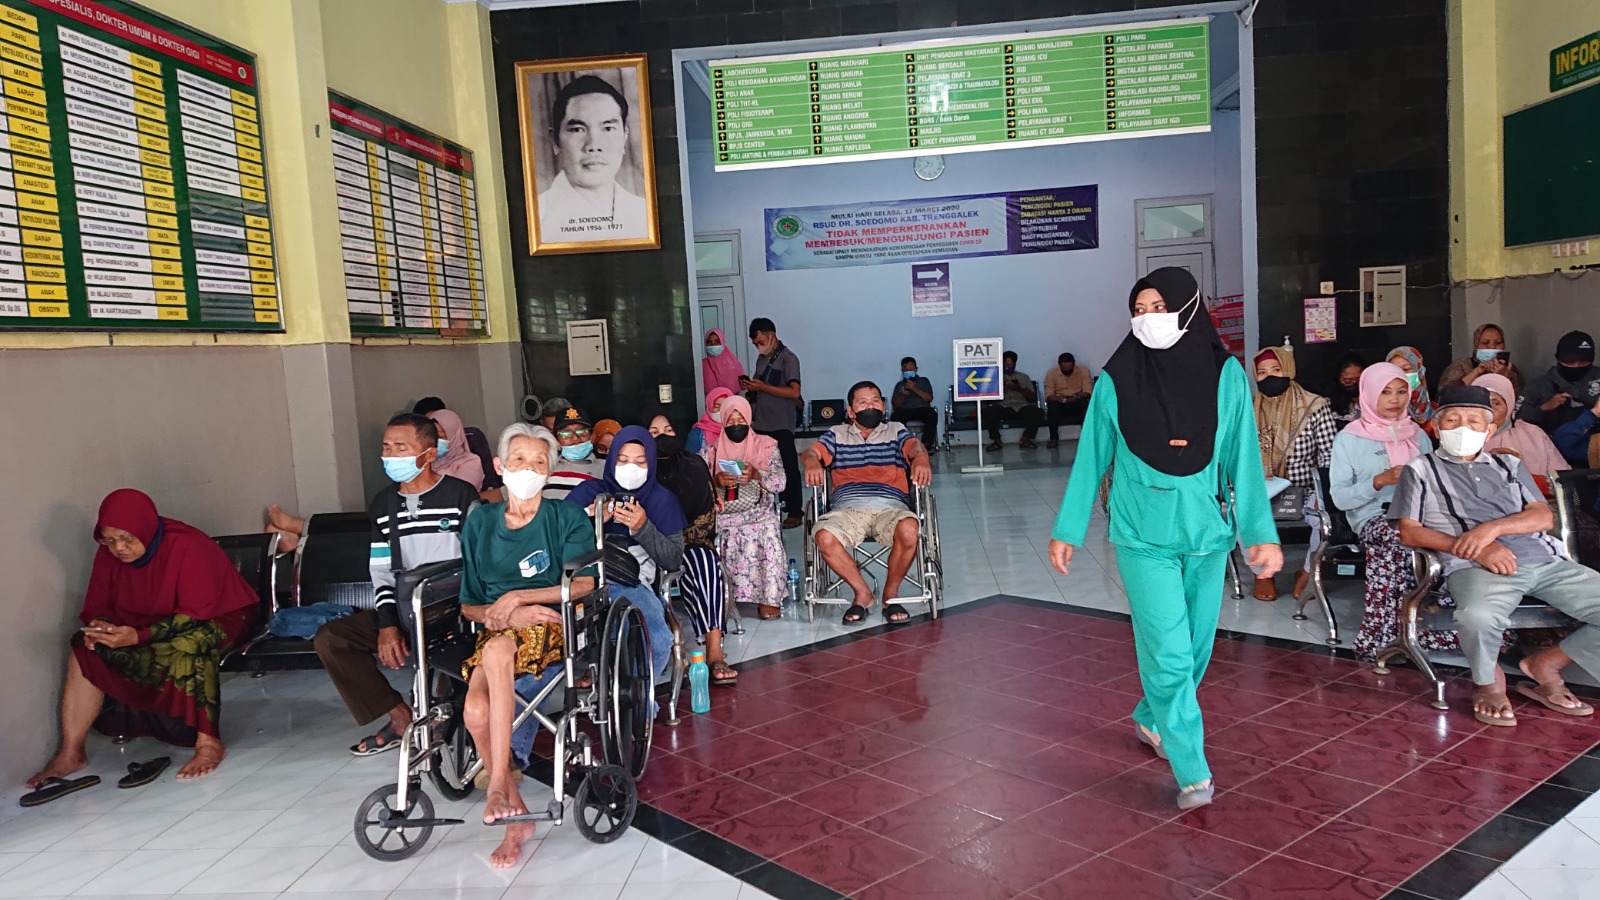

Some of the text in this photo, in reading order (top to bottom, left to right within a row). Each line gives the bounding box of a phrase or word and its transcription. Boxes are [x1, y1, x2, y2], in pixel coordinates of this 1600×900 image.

[50, 0, 200, 60] PESIALIS, DOKTER UMUM & DOKTER GIGI
[1130, 33, 1146, 41] PARU
[1016, 41, 1073, 52] RUANG MANAJEMEN
[1117, 42, 1174, 53] INSTALASI FARMASI
[930, 50, 963, 59] PENGADUAN
[964, 47, 1000, 57] MASYARAKAT
[1016, 54, 1036, 62] RUANG
[1117, 51, 1195, 64] INSTALASI BEDAH SENTRAL
[820, 58, 869, 69] RUANG MATAHARI
[917, 61, 966, 71] RUANG BERSALIN
[14, 68, 29, 78] MATA
[725, 67, 767, 77] LABORATORIUM
[820, 69, 863, 79] RUANG SAKURA
[1117, 63, 1185, 75] INSTALASI AMBULANCE
[1117, 73, 1197, 86] INSTALASI KAMAR JENAZAH
[821, 80, 862, 90] RUANG DAHLIA
[17, 87, 34, 97] SARAF
[821, 90, 863, 100] RUANG SERUNI
[1118, 85, 1180, 96] INSTALASI RADIOLOGI
[1118, 98, 1151, 107] PELAYANAN
[1174, 94, 1201, 103] TERPADU
[822, 101, 863, 111] RUANG MELATI
[741, 108, 774, 117] FISIOTERAPI
[822, 111, 869, 122] RUANG ANGGREK
[1119, 108, 1151, 118] INFORMASI
[1018, 117, 1050, 126] PELAYANAN
[1052, 116, 1067, 124] OBAT
[1119, 119, 1152, 128] PELAYANAN
[21, 123, 39, 134] THT-KL
[823, 121, 877, 132] RUANG FLAMBOYAN
[777, 128, 793, 136] SKTM
[1018, 129, 1038, 137] RUANG
[1048, 127, 1064, 135] SCAN
[824, 133, 866, 143] RUANG MAWAR
[921, 135, 977, 146] LOKET PEMBAYARAN
[744, 140, 765, 149] CENTER
[824, 143, 871, 153] RUANG RAFLESIA
[24, 179, 49, 189] ANASTESI
[855, 217, 898, 226] SOEDOMO
[900, 214, 920, 223] KAB.
[922, 210, 979, 221] TRENGGALEK
[826, 221, 967, 238] TIDAK MEMPERKENANKAN
[805, 228, 989, 249] MEMBESUK/MENGUNJUNGI PASIEN
[32, 270, 60, 279] RADIOLOGI
[964, 344, 992, 357] PAT
